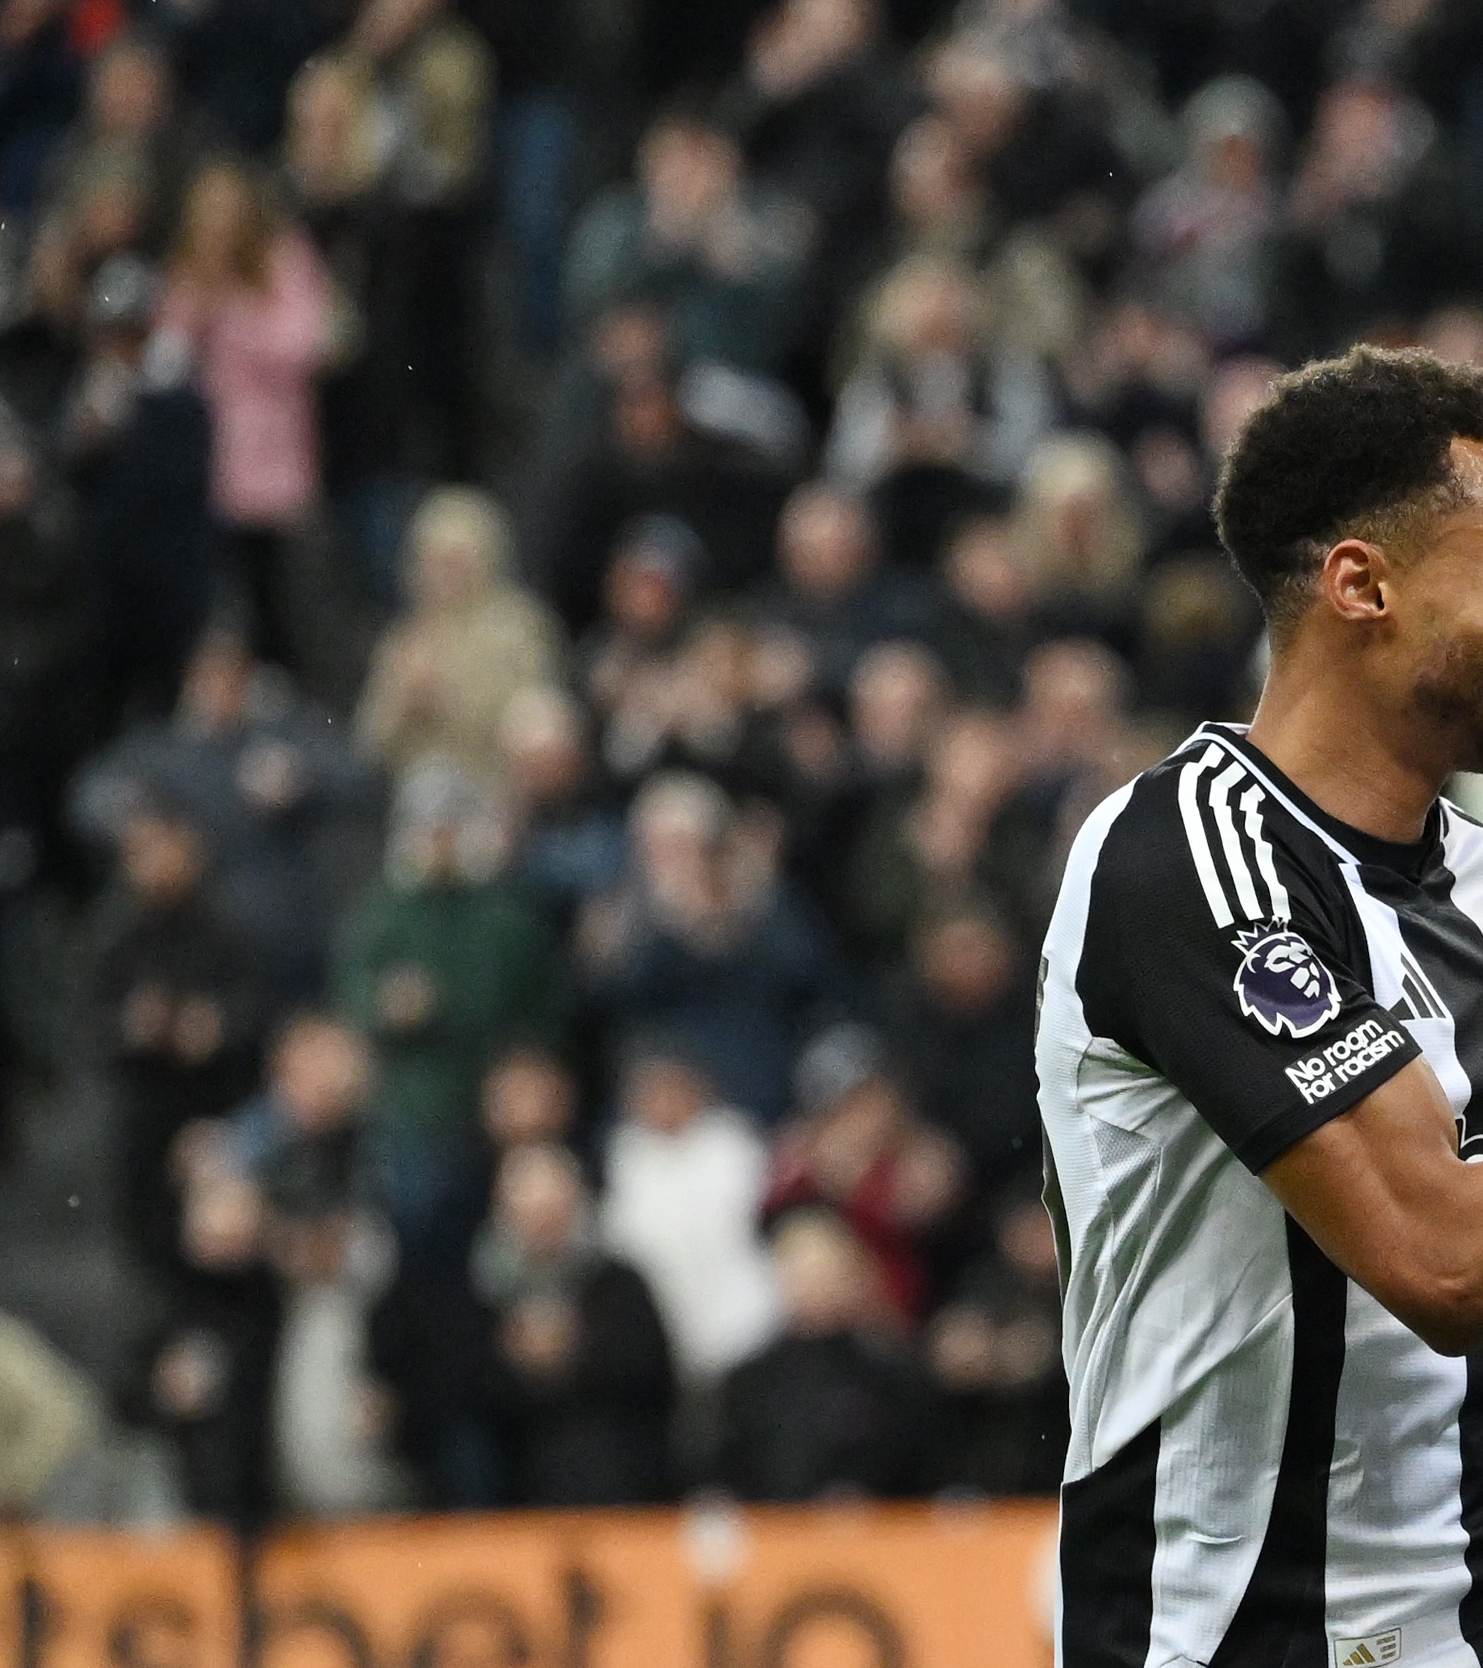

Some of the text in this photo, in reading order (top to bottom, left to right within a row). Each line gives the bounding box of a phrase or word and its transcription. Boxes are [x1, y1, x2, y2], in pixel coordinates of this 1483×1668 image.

[1284, 1019, 1384, 1088] No room
[1299, 1030, 1405, 1105] for racism
